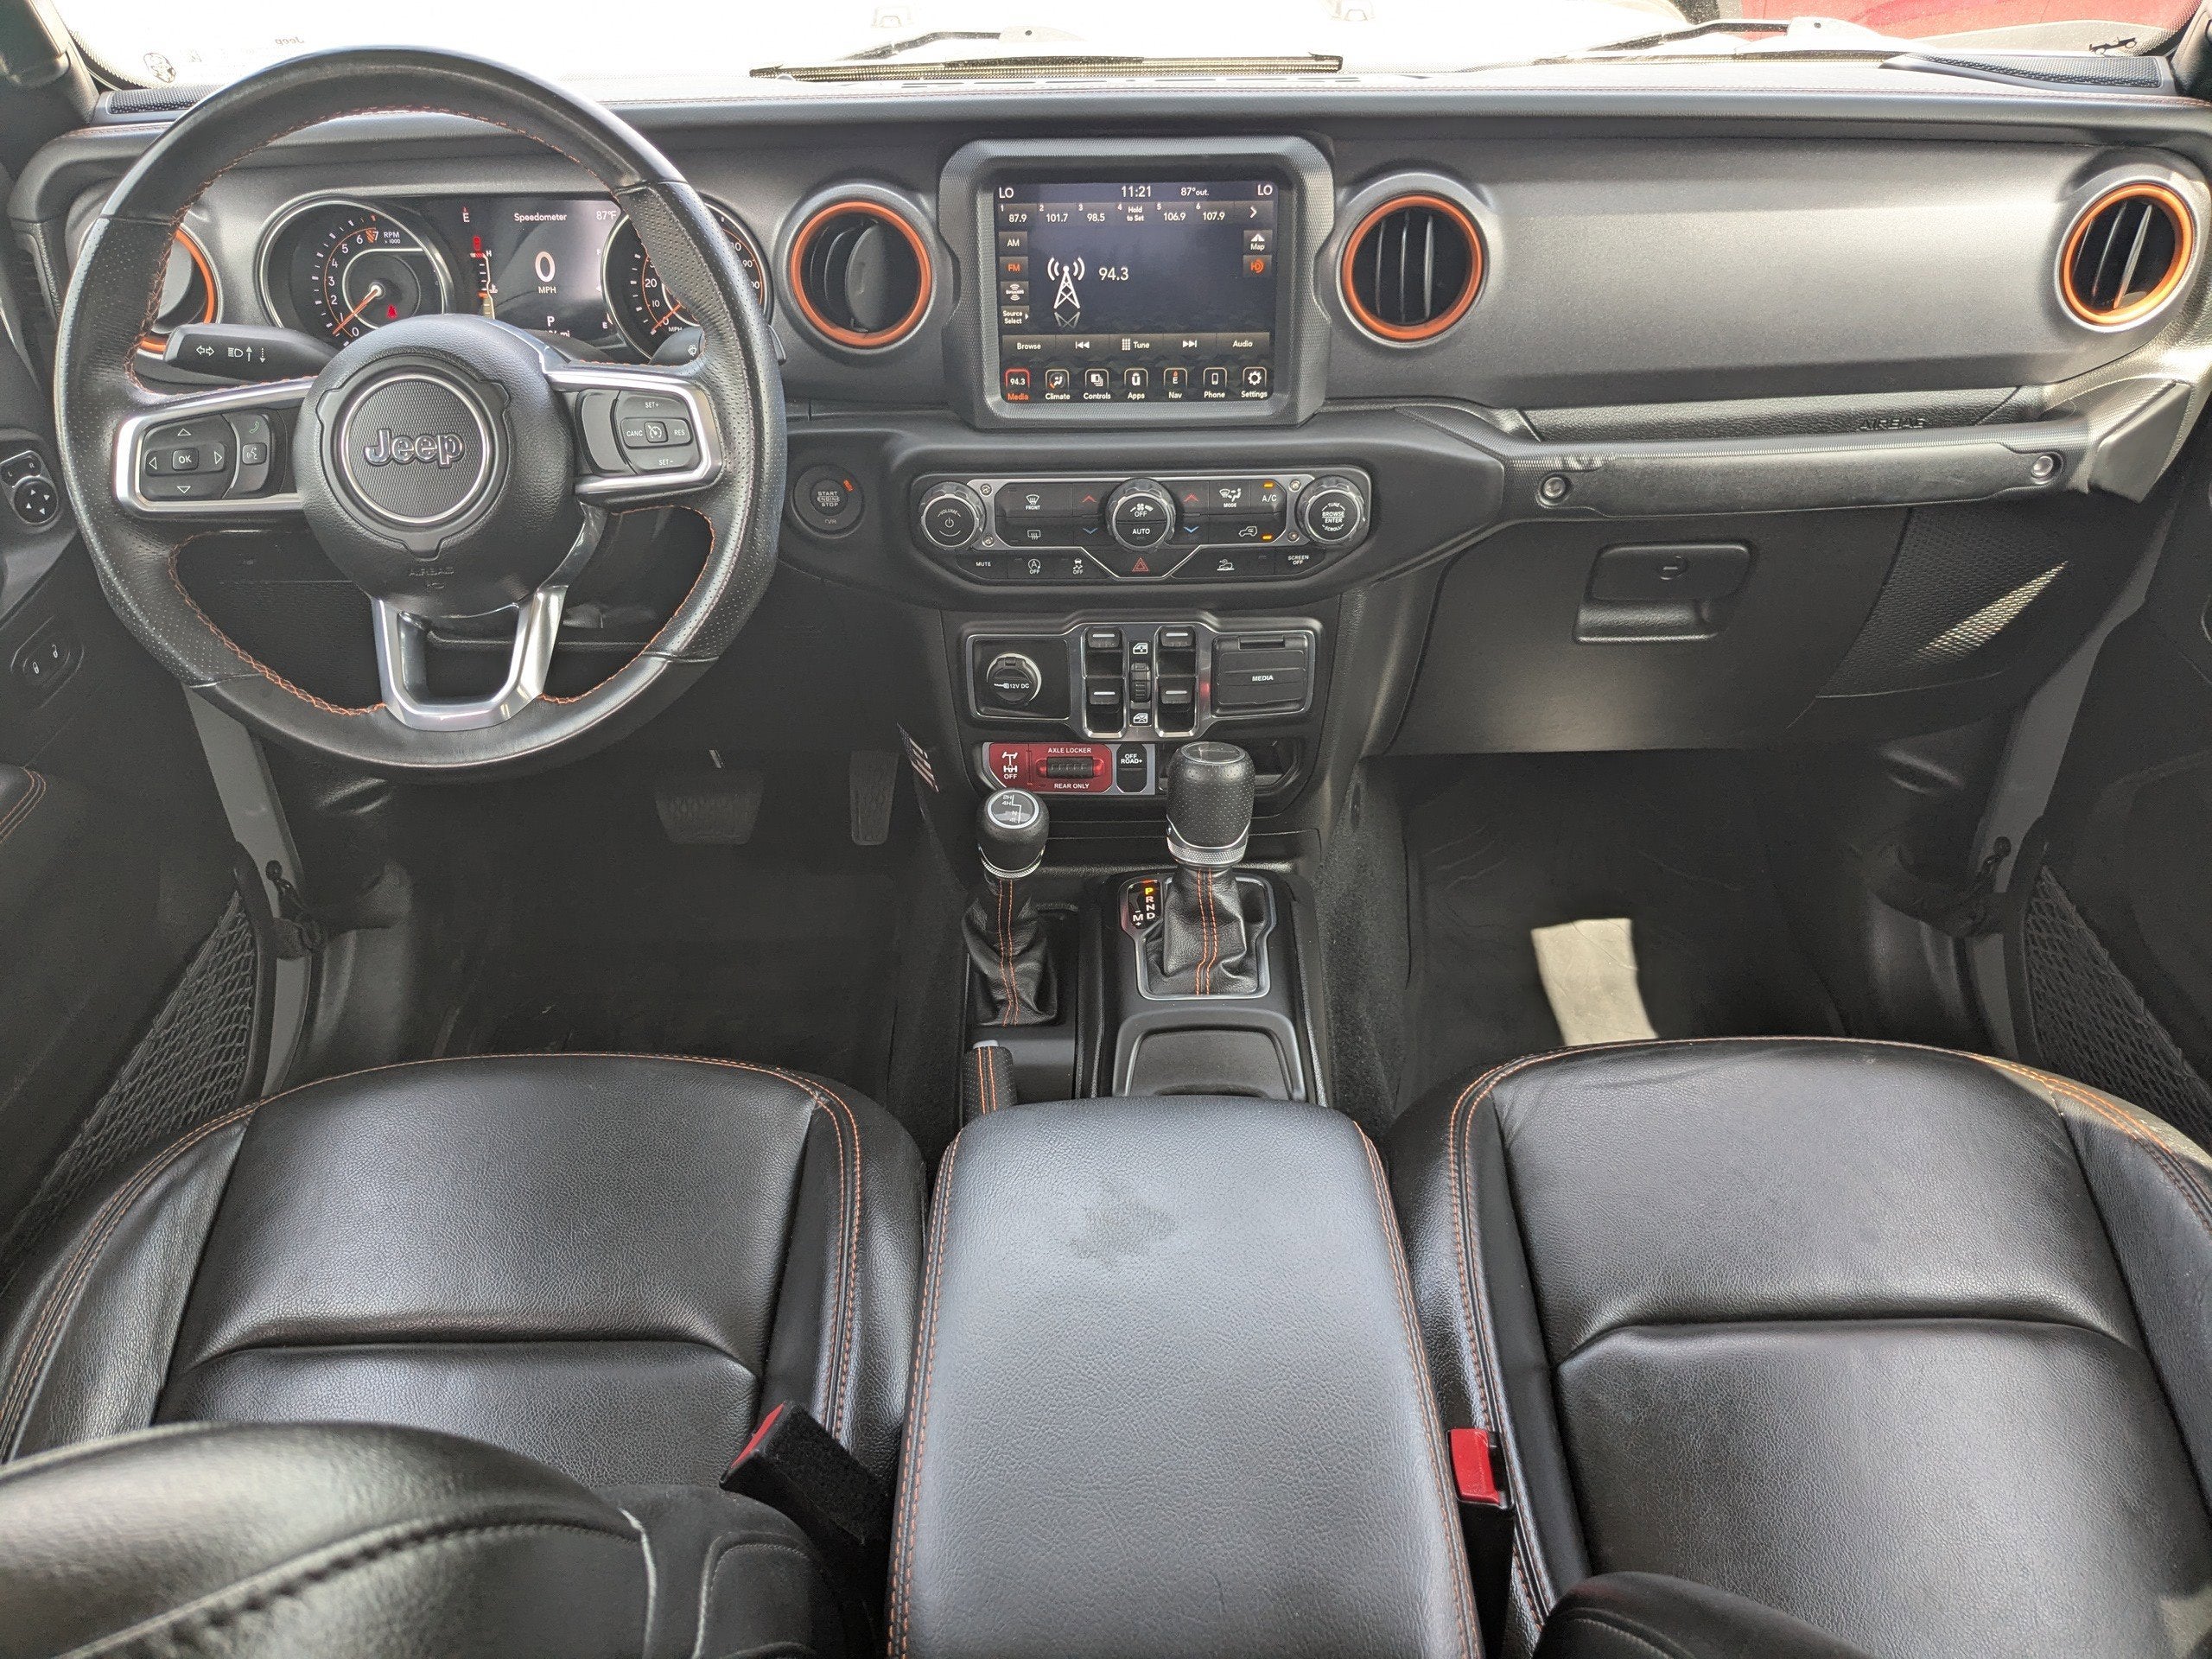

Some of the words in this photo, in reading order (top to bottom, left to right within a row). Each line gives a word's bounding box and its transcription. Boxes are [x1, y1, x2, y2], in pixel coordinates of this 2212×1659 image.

[999, 187, 1014, 198] LO
[1122, 185, 1151, 198] 11:21
[1257, 184, 1273, 196] LO
[514, 213, 568, 222] Speedometer
[1008, 213, 1027, 223] 87.9
[1046, 213, 1069, 223] 101.7
[1087, 213, 1105, 222] 98.5
[1163, 212, 1186, 221] 106.9
[1202, 212, 1225, 221] 107.9
[356, 234, 364, 245] 6
[372, 231, 379, 241] 7
[1007, 238, 1020, 247] AM
[341, 244, 349, 254] 5
[331, 258, 339, 268] 4
[535, 251, 556, 283] 0
[742, 259, 753, 268] 90
[1007, 264, 1020, 272] FM
[1098, 267, 1129, 281] 94.3
[328, 276, 335, 286] 3
[645, 278, 658, 288] 20
[330, 296, 338, 305] 2
[547, 315, 555, 327] P
[352, 327, 359, 337] 0
[1009, 378, 1026, 386] 94.3
[1241, 391, 1268, 399] Settings
[364, 428, 465, 468] Jeep
[178, 455, 192, 464] OK
[1132, 913, 1144, 922] M
